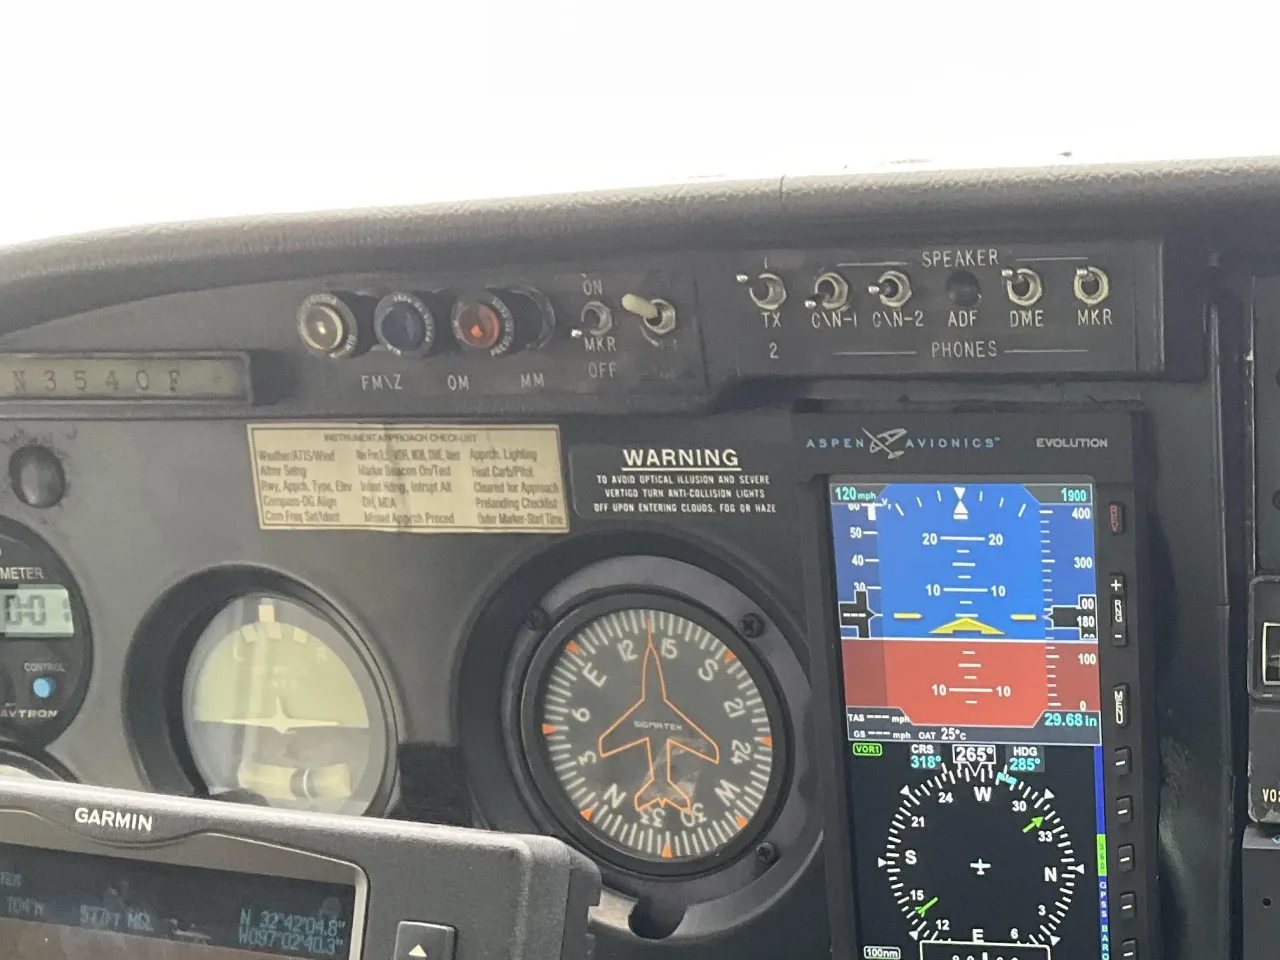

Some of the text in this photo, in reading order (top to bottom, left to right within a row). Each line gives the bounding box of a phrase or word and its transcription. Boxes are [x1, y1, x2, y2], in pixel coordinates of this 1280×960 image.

[922, 250, 999, 267] SPEAKER
[582, 280, 603, 296] ON
[762, 312, 782, 328] TX
[948, 311, 978, 327] ADF
[1010, 310, 1044, 327] DME
[1077, 308, 1112, 326] MKR
[584, 337, 617, 352] MKR
[931, 341, 998, 358] PHONES
[588, 362, 617, 378] OFF
[447, 376, 470, 390] OM
[520, 373, 544, 388] MM
[806, 438, 864, 448] ASPEN
[1036, 438, 1108, 448] EVOLUTION
[622, 449, 739, 466] WARNING
[597, 475, 770, 484] TO AVOID OPTICAL ILLUSION AND SEVERE
[605, 489, 765, 498] VERTIGO TURN ANTI-COLLISION LIGHTS
[836, 487, 856, 500] 120
[1061, 488, 1086, 501] 1900
[594, 503, 608, 512] OFF
[613, 504, 634, 512] UPON
[639, 504, 677, 512] ENTERING
[740, 504, 751, 512] OR
[756, 504, 776, 513] HAZE
[1072, 507, 1090, 519] 400
[1074, 557, 1092, 568] 300
[1044, 713, 1083, 726] 29.68
[911, 744, 934, 754] CRS
[1013, 746, 1038, 756] HDG
[74, 808, 153, 832] GARMIN
